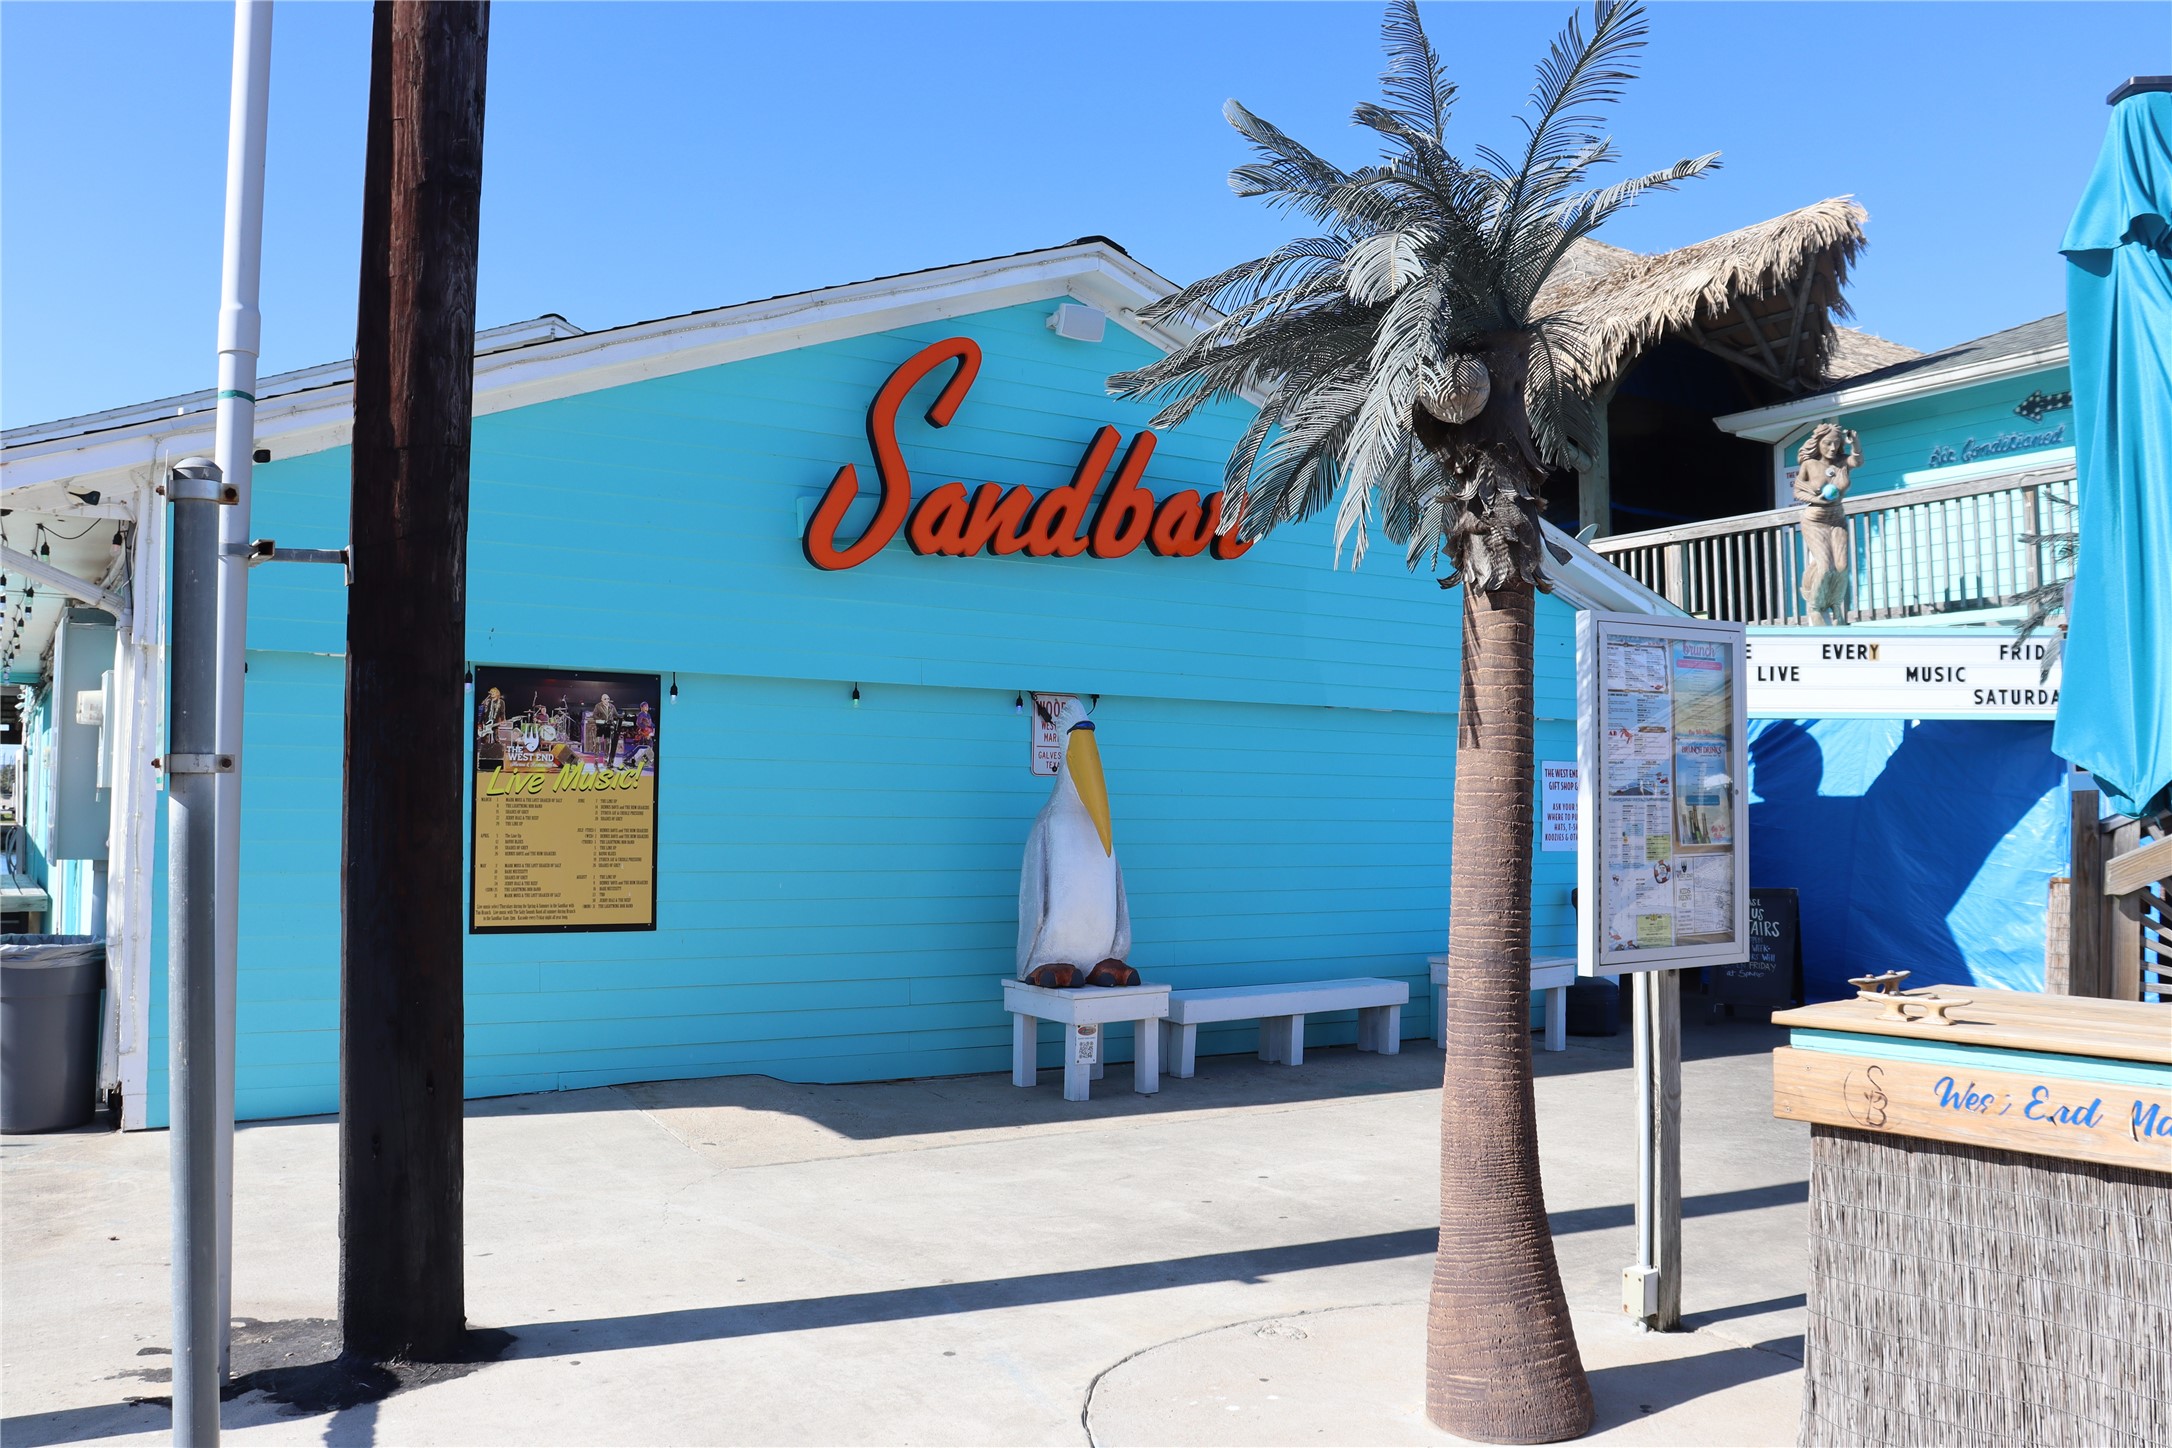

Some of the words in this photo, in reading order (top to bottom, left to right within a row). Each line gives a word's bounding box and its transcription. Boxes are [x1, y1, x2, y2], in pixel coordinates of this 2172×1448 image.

[1929, 445, 1956, 468] Air
[1962, 424, 2065, 462] Conditioned
[802, 336, 1254, 571] Sandbar
[1822, 644, 1879, 660] EVERY
[2000, 644, 2046, 660] FRID
[1757, 666, 1800, 682] LIVE
[1906, 667, 1966, 682] MUSIC
[1974, 689, 2060, 705] SATURDA
[1044, 733, 1057, 742] MAR
[508, 753, 535, 761] WEST
[536, 754, 554, 762] END
[1038, 751, 1062, 759] GALVES
[486, 765, 545, 796] Live
[552, 761, 645, 794] Music!
[1545, 769, 1554, 777] THE
[1555, 769, 1568, 778] WEST
[1549, 782, 1560, 790] GIFT
[1561, 782, 1574, 790] SHOP
[1554, 824, 1568, 832] HATS,
[1751, 908, 1764, 920] US
[1750, 920, 1780, 937] AIRS
[1749, 962, 1776, 972] FRIDAY
